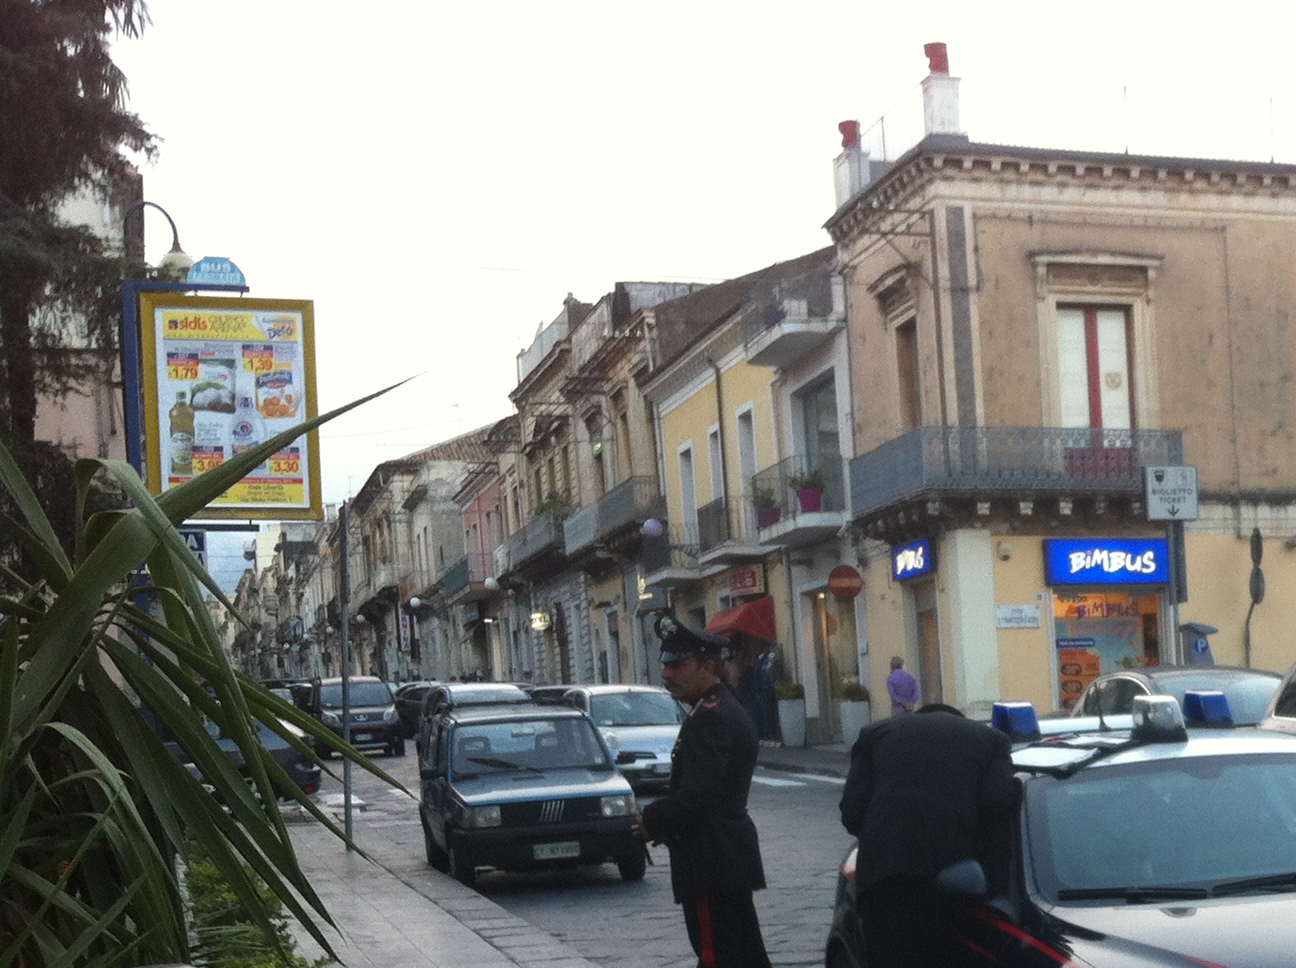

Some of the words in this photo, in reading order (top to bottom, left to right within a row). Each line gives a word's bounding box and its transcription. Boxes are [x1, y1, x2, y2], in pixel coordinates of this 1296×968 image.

[1152, 487, 1193, 496] BIGLIETTO
[1160, 496, 1187, 504] TICKET
[1197, 638, 1207, 653] P
